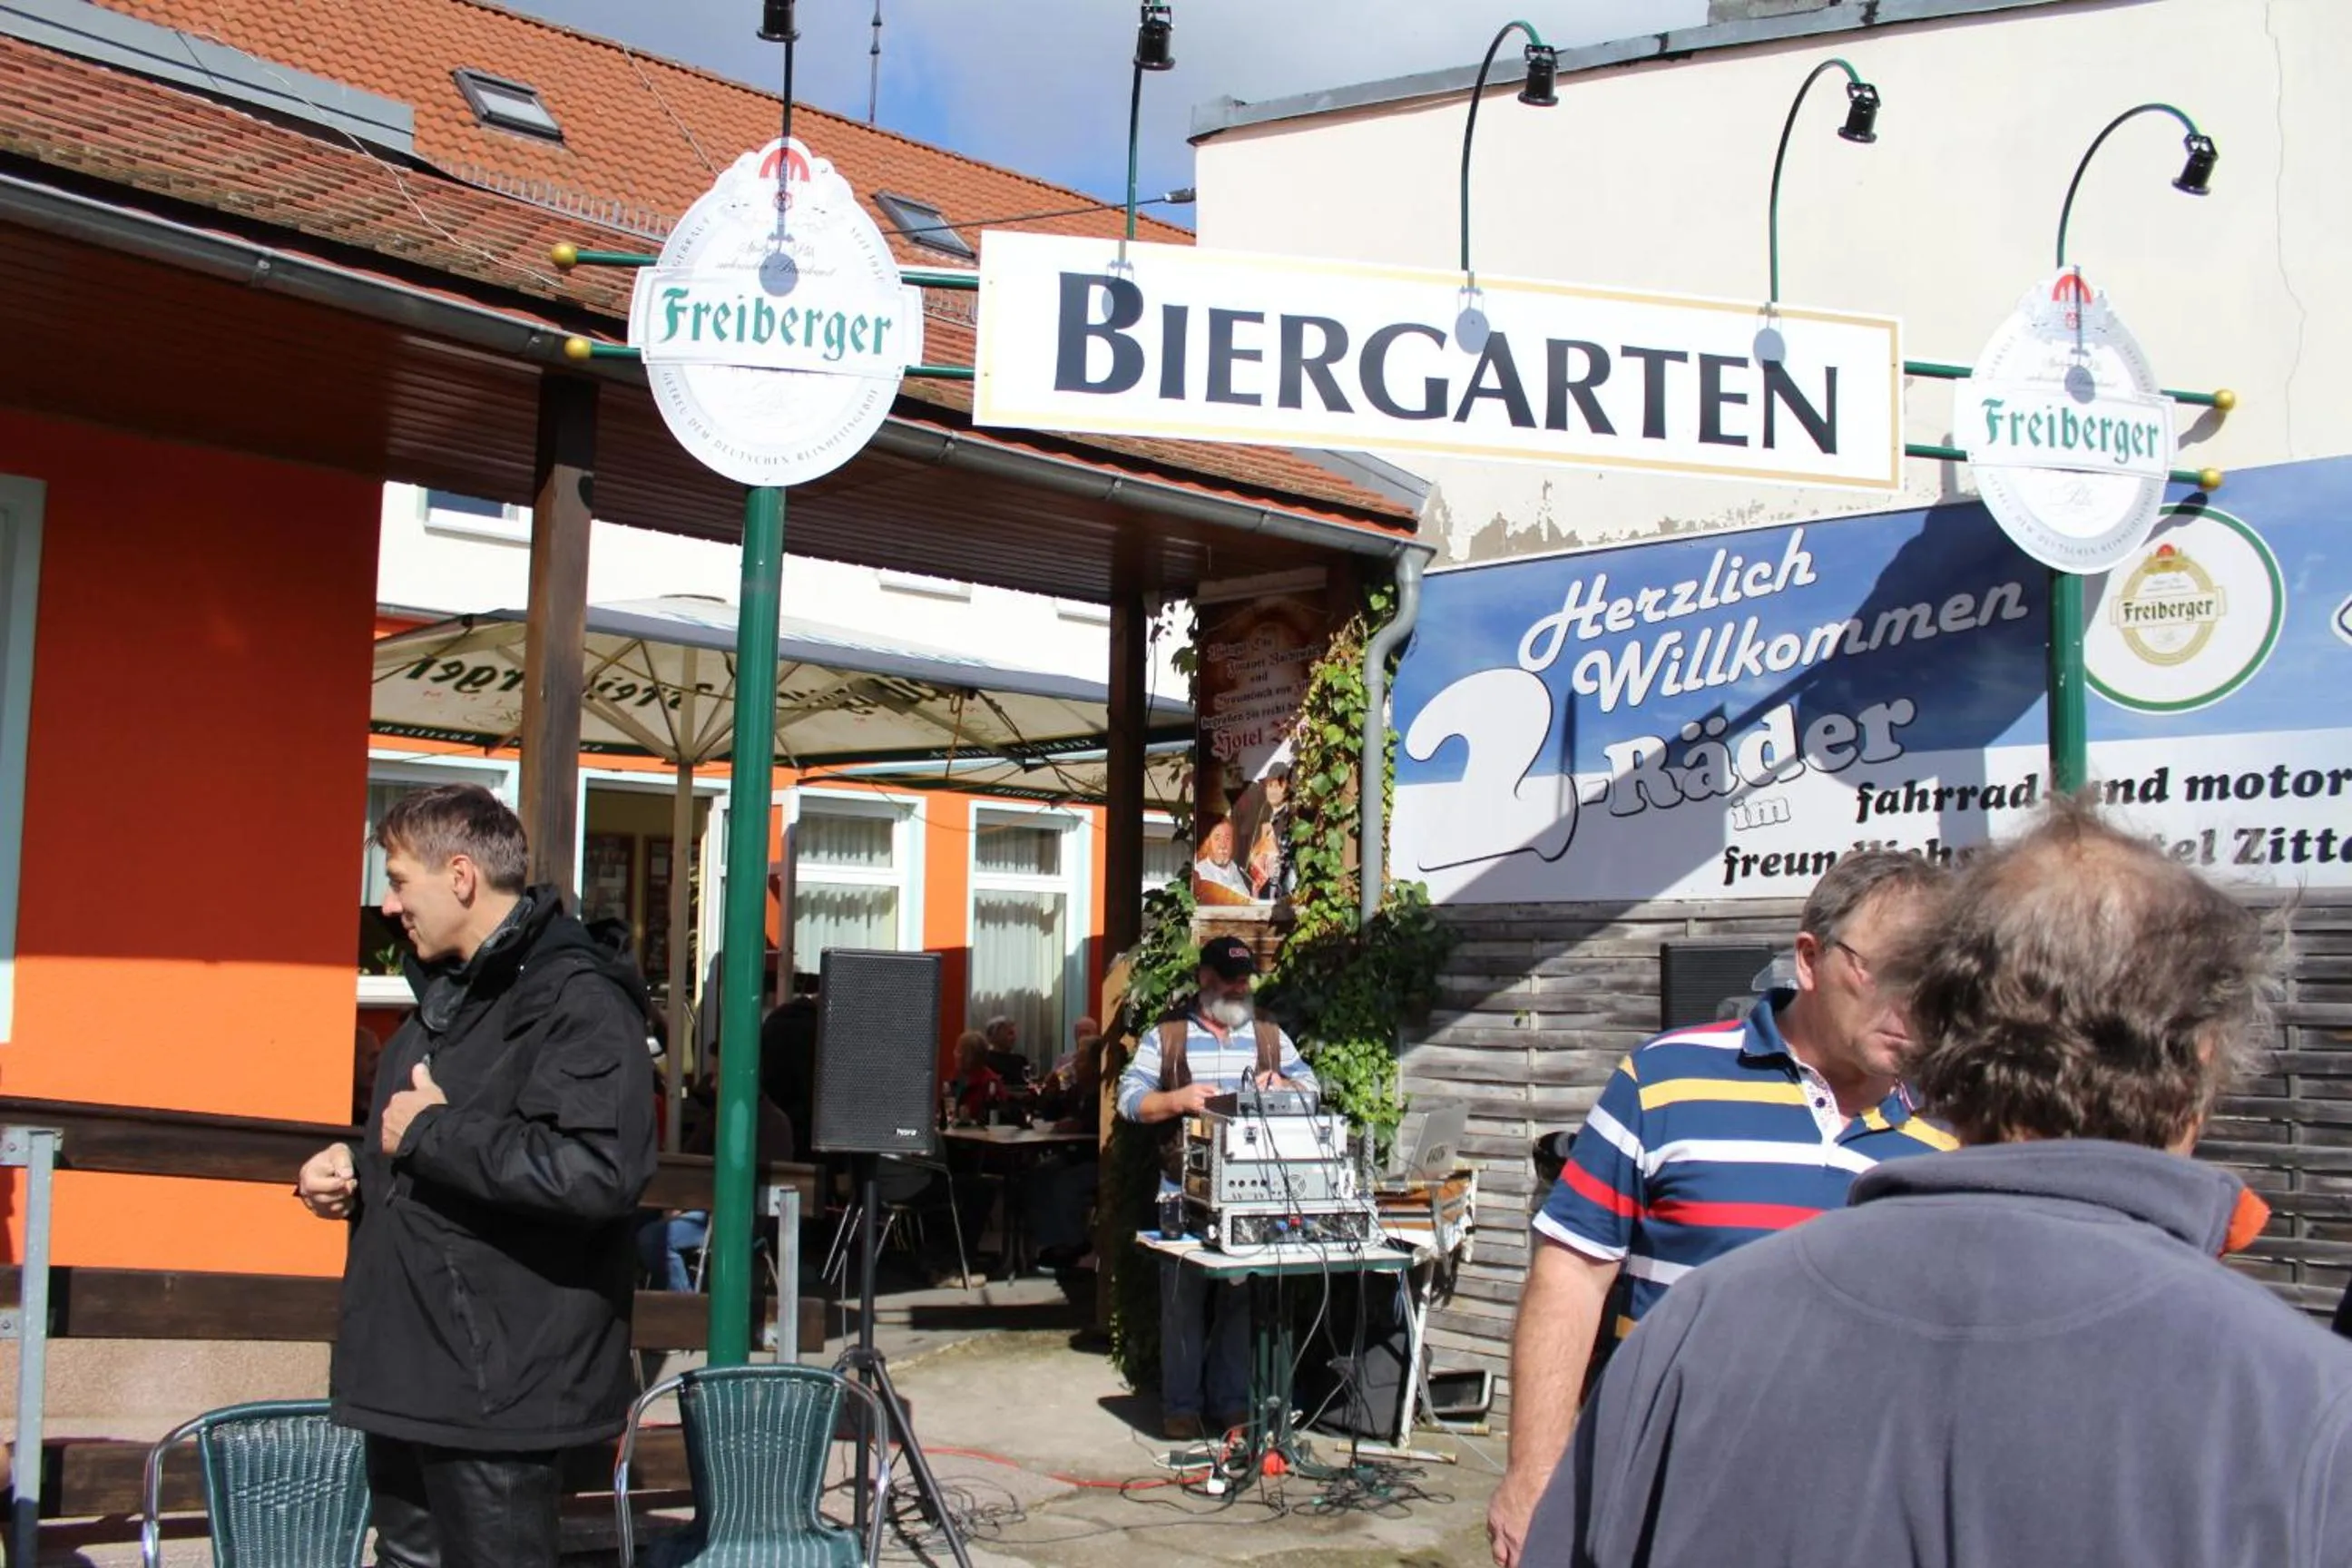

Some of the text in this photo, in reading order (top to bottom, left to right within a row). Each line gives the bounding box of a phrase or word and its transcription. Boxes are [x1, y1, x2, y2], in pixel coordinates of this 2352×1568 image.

[660, 287, 894, 362] Freiberger
[1054, 270, 1838, 456] BIERGARTEN
[1981, 397, 2160, 465] Freiberger
[1517, 527, 1818, 672] Herzlich
[2122, 599, 2214, 622] Freiberger
[1570, 582, 2029, 714] Willkommen
[1211, 727, 1264, 761] Hotel
[1730, 794, 1791, 832] im
[1856, 773, 2037, 824] fahrrad
[2183, 764, 2352, 803] motor
